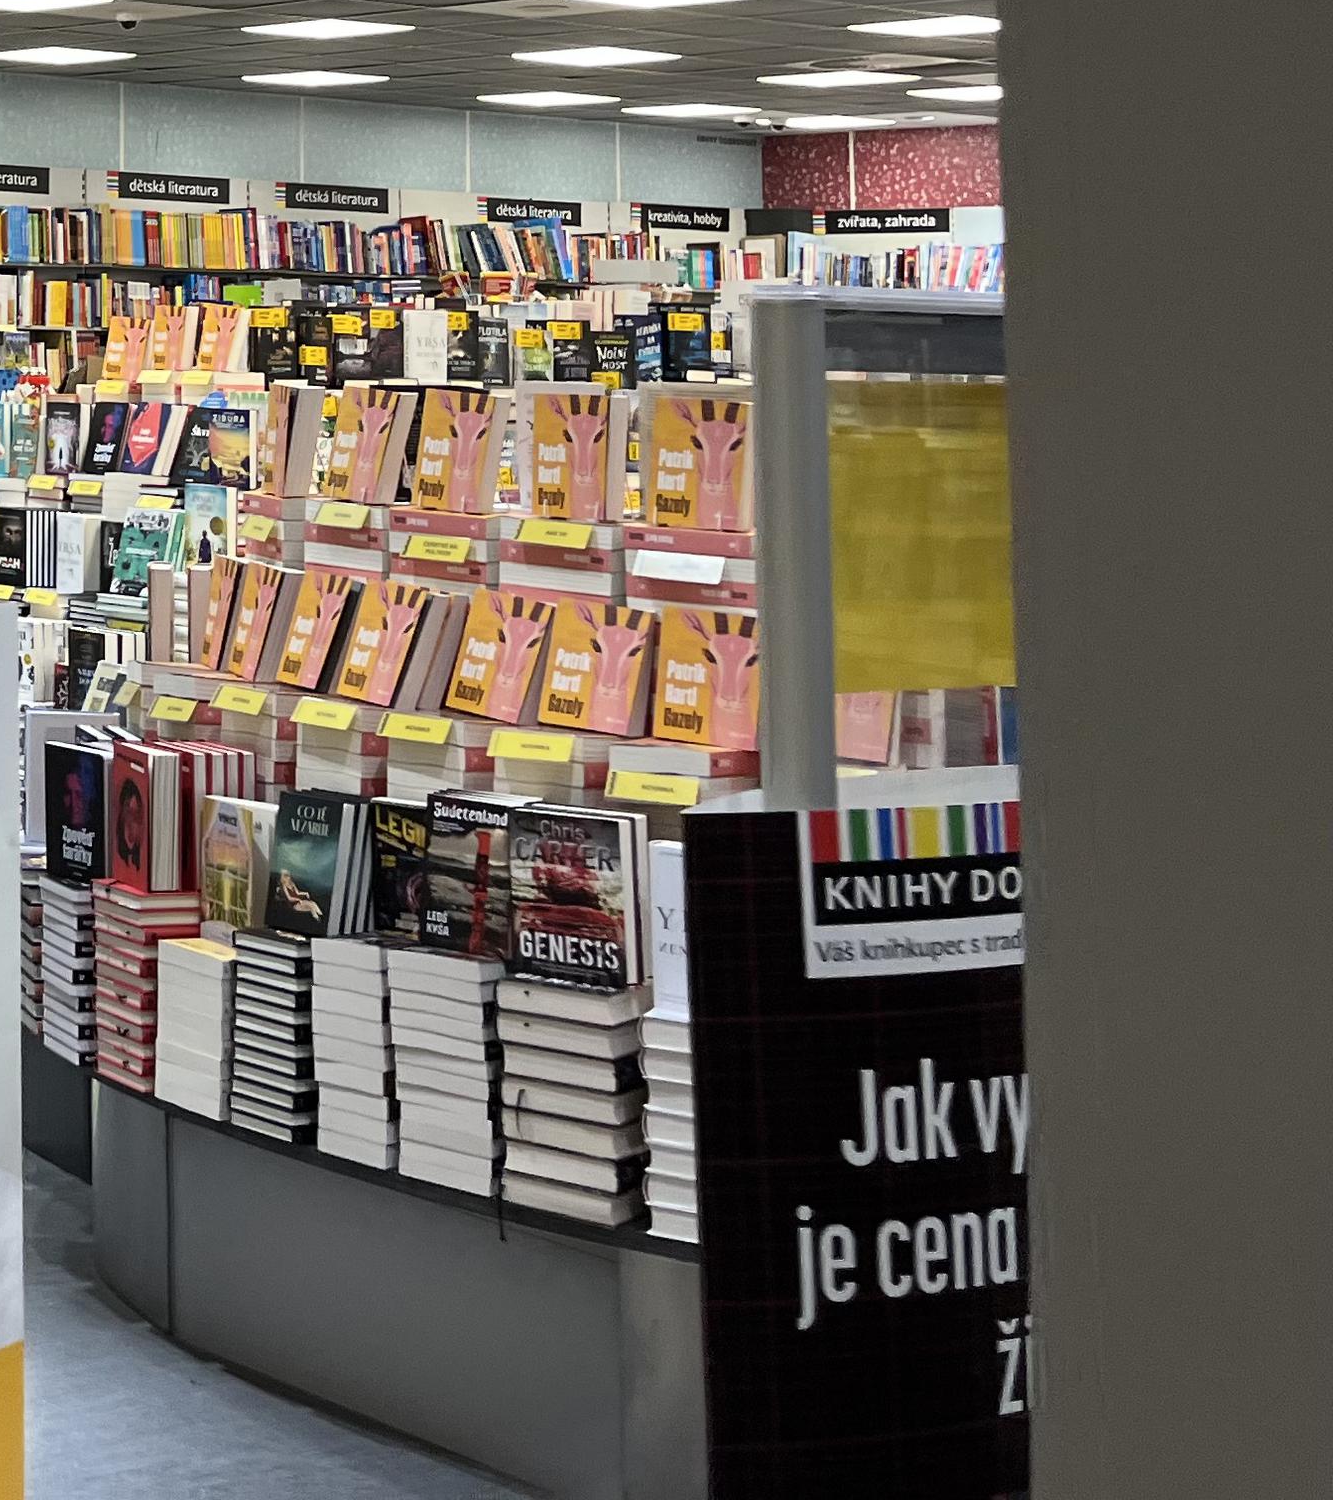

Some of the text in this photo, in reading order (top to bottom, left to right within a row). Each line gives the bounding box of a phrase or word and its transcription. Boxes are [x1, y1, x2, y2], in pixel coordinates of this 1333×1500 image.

[129, 178, 219, 198] dětská literatura
[295, 188, 379, 207] dětská literatura
[496, 203, 572, 221] dětská literatura
[694, 212, 722, 229] hobby
[837, 213, 936, 230] zvířata, zahrada
[433, 801, 509, 827] Sudetenland
[539, 819, 585, 841] Chris
[514, 837, 616, 873] CARTER
[824, 866, 1023, 910] KNIHY DO
[813, 936, 980, 963] Váš knihkupec s
[841, 1058, 960, 1167] Jak
[795, 1204, 1019, 1331] je cena
